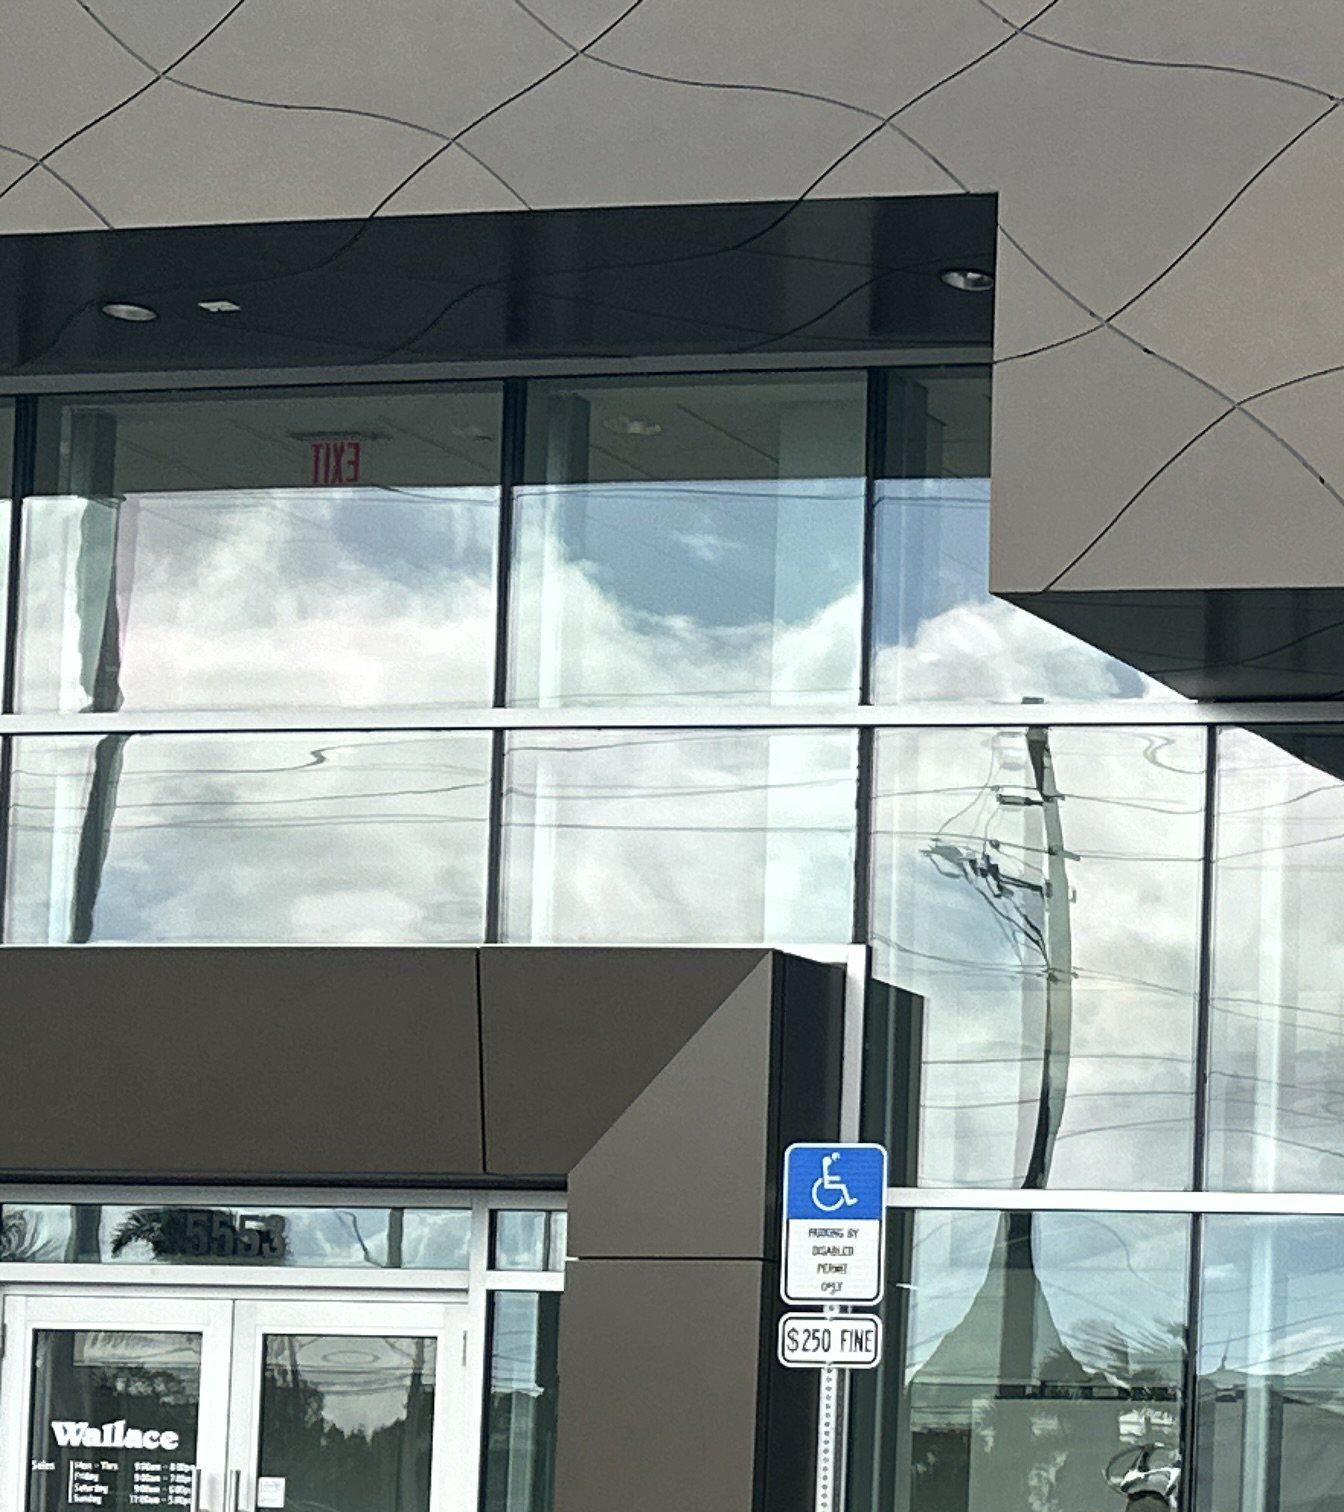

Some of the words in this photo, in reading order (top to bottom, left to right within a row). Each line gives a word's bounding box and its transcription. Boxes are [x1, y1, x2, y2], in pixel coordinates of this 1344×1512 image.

[808, 1227, 844, 1239] PARKING
[847, 1227, 860, 1239] BY
[811, 1245, 855, 1257] DISABLED
[817, 1263, 848, 1274] PERMIT
[820, 1281, 843, 1293] ONLY
[786, 1327, 832, 1353] $250
[840, 1328, 874, 1353] FINE
[51, 1419, 180, 1450] Wallace
[31, 1459, 55, 1470] Sales
[74, 1472, 99, 1483] Friday
[74, 1483, 109, 1495] Saturday
[73, 1493, 102, 1505] Sunday
